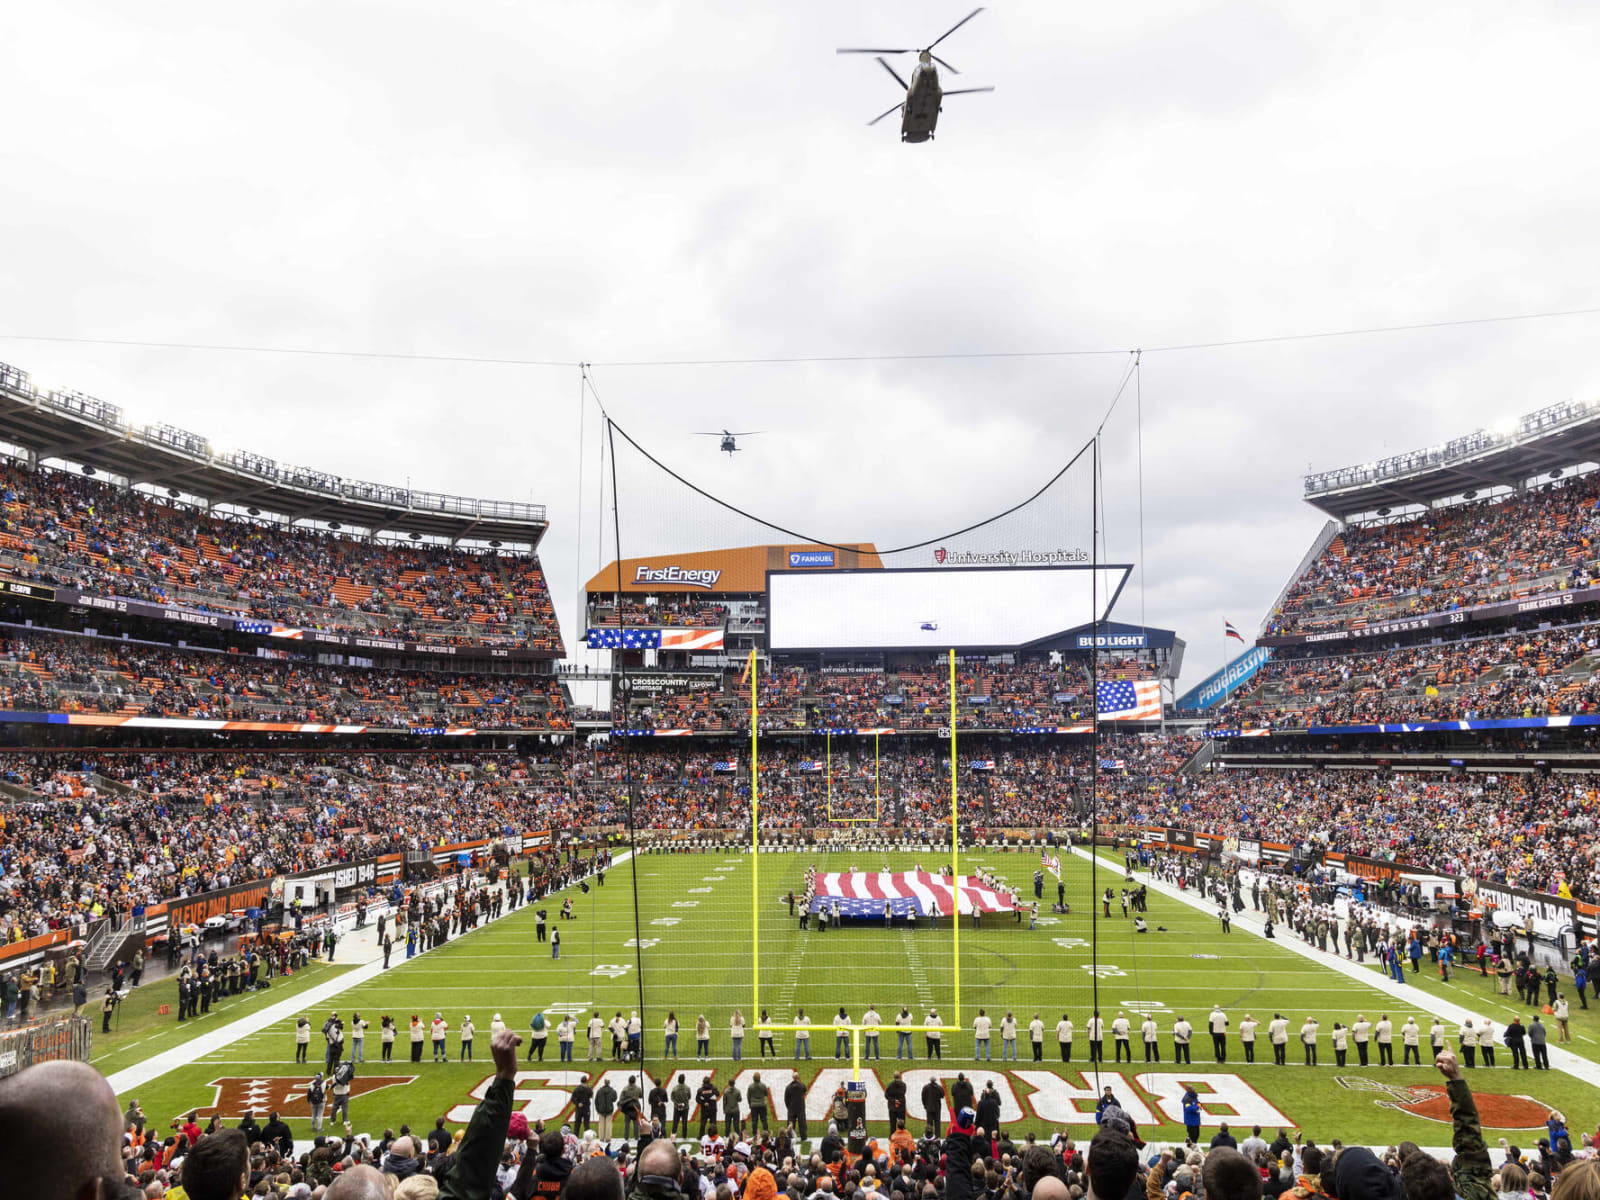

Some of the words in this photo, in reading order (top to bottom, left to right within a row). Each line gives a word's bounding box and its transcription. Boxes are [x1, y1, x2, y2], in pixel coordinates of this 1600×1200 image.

[801, 555, 833, 563] FANDUEL
[946, 550, 1018, 565] University
[1022, 548, 1088, 564] Hospitals
[635, 565, 720, 583] FirstEnergy
[209, 617, 218, 626] 42
[1079, 637, 1106, 647] BUD
[1107, 636, 1144, 646] LIGHT
[631, 678, 688, 686] CROSSCOUNTRY
[358, 863, 375, 883] 1946
[1348, 860, 1392, 881] CLEVELAND
[171, 897, 228, 928] CLEVELAND
[229, 886, 270, 913] BROWNS
[1479, 887, 1543, 921] ESTABLISHED
[1543, 902, 1573, 927] 1946
[1081, 965, 1128, 976] 20
[1120, 1001, 1174, 1014] 10
[444, 1069, 1299, 1129] BROWNS
[704, 1143, 720, 1157] 24
